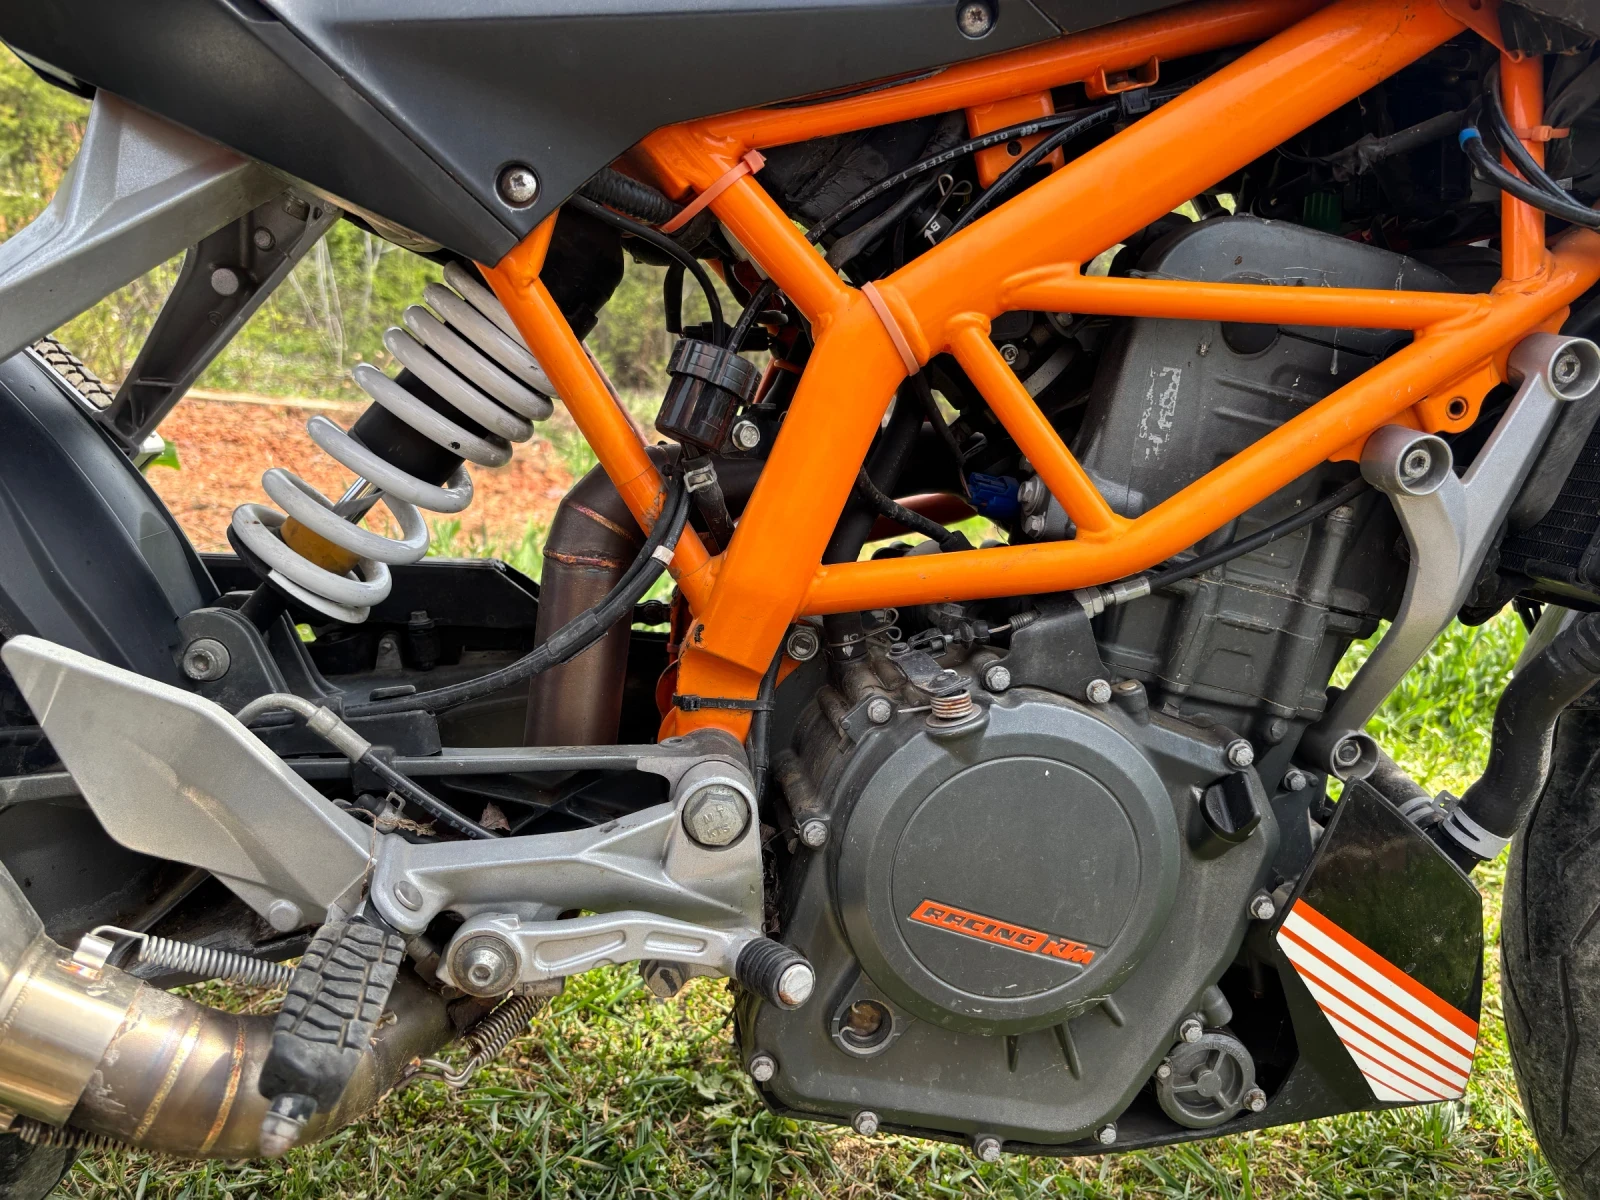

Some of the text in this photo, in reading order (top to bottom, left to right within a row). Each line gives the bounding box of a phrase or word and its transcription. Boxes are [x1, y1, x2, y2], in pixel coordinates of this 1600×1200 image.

[962, 143, 974, 154] N
[917, 151, 955, 172] PTFE
[921, 906, 1096, 966] RACING KTM
